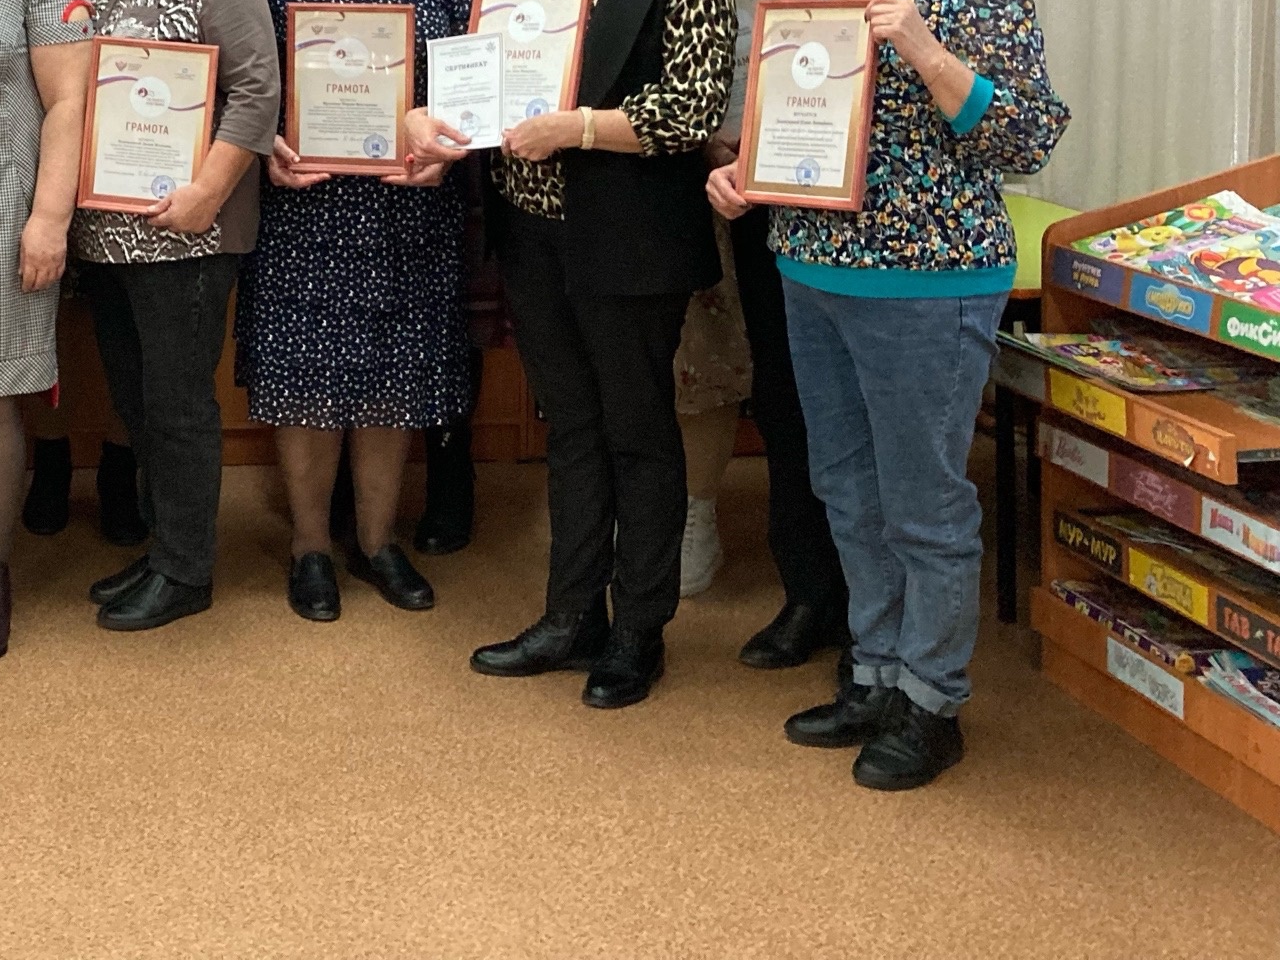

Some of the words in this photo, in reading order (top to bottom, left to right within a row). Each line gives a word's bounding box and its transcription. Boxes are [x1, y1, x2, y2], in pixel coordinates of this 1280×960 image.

[505, 49, 542, 60] РАМОТА
[325, 83, 370, 94] ГРАМОТА
[786, 96, 827, 108] ГРАМОТА
[125, 121, 169, 136] ГРАМОТА
